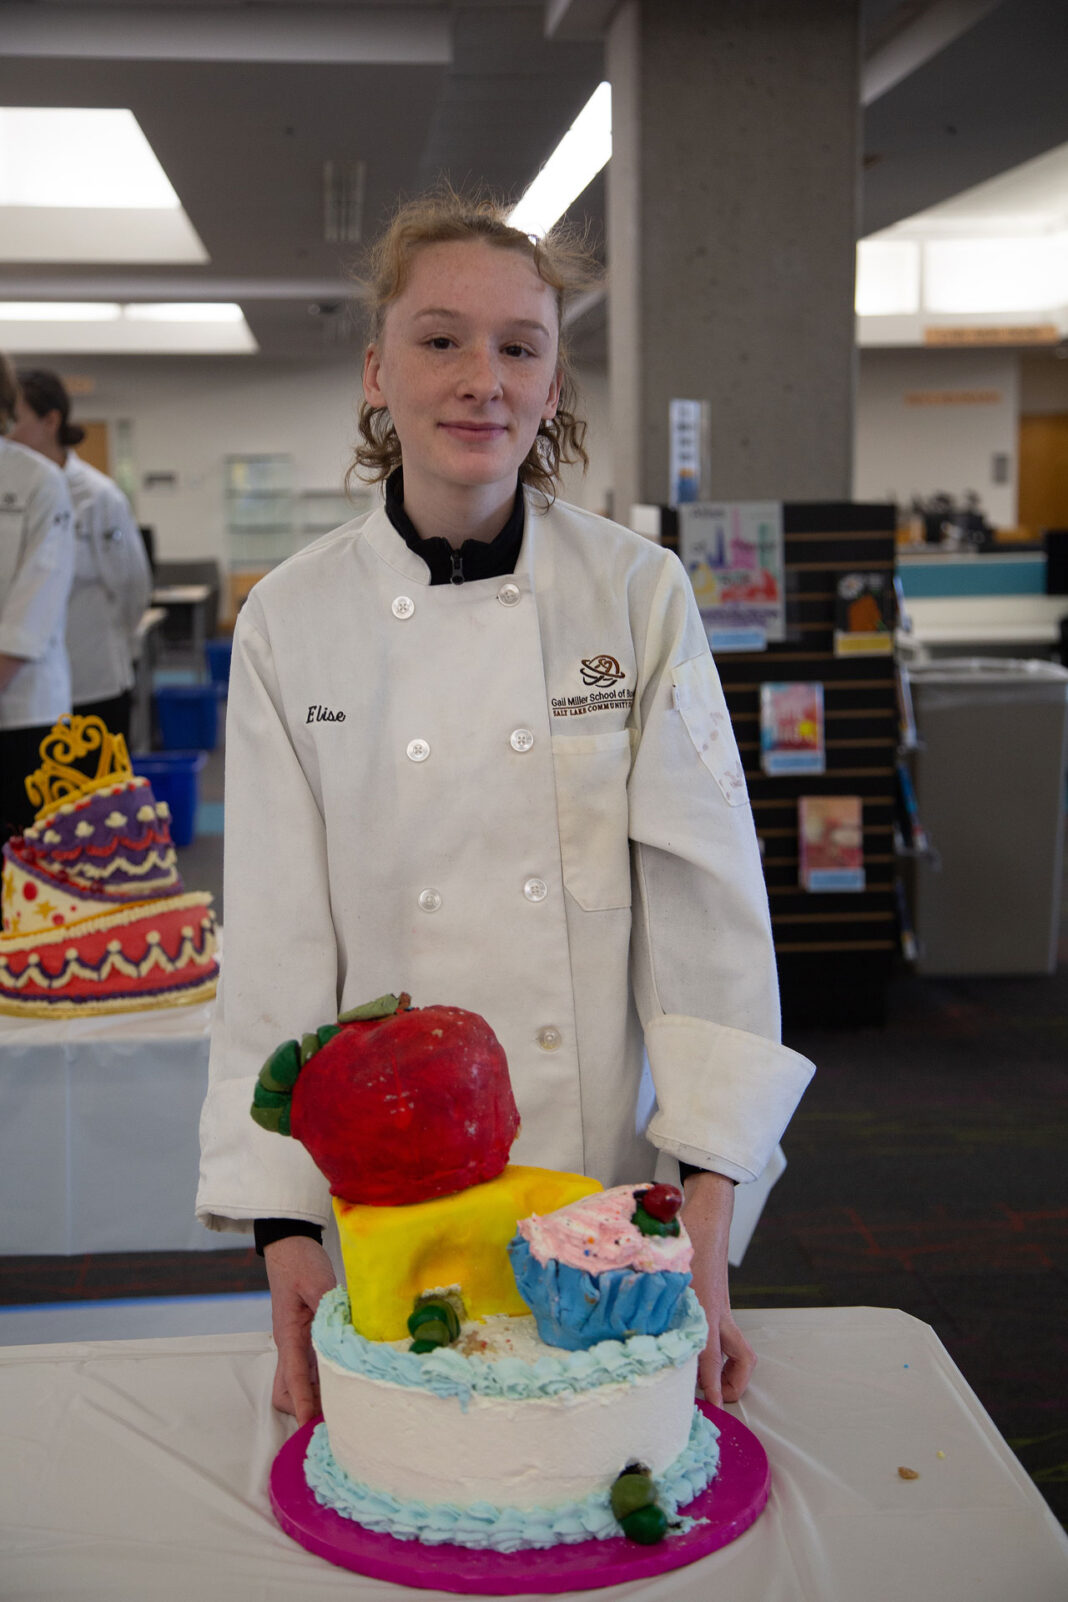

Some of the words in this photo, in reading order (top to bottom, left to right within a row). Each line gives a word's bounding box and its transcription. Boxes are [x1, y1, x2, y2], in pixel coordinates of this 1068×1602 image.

[551, 698, 567, 707] Gail
[567, 696, 589, 706] Miller
[589, 689, 617, 702] School
[617, 689, 626, 699] of
[306, 705, 346, 724] Elise
[553, 709, 568, 717] SALT
[569, 707, 587, 716] LAKE
